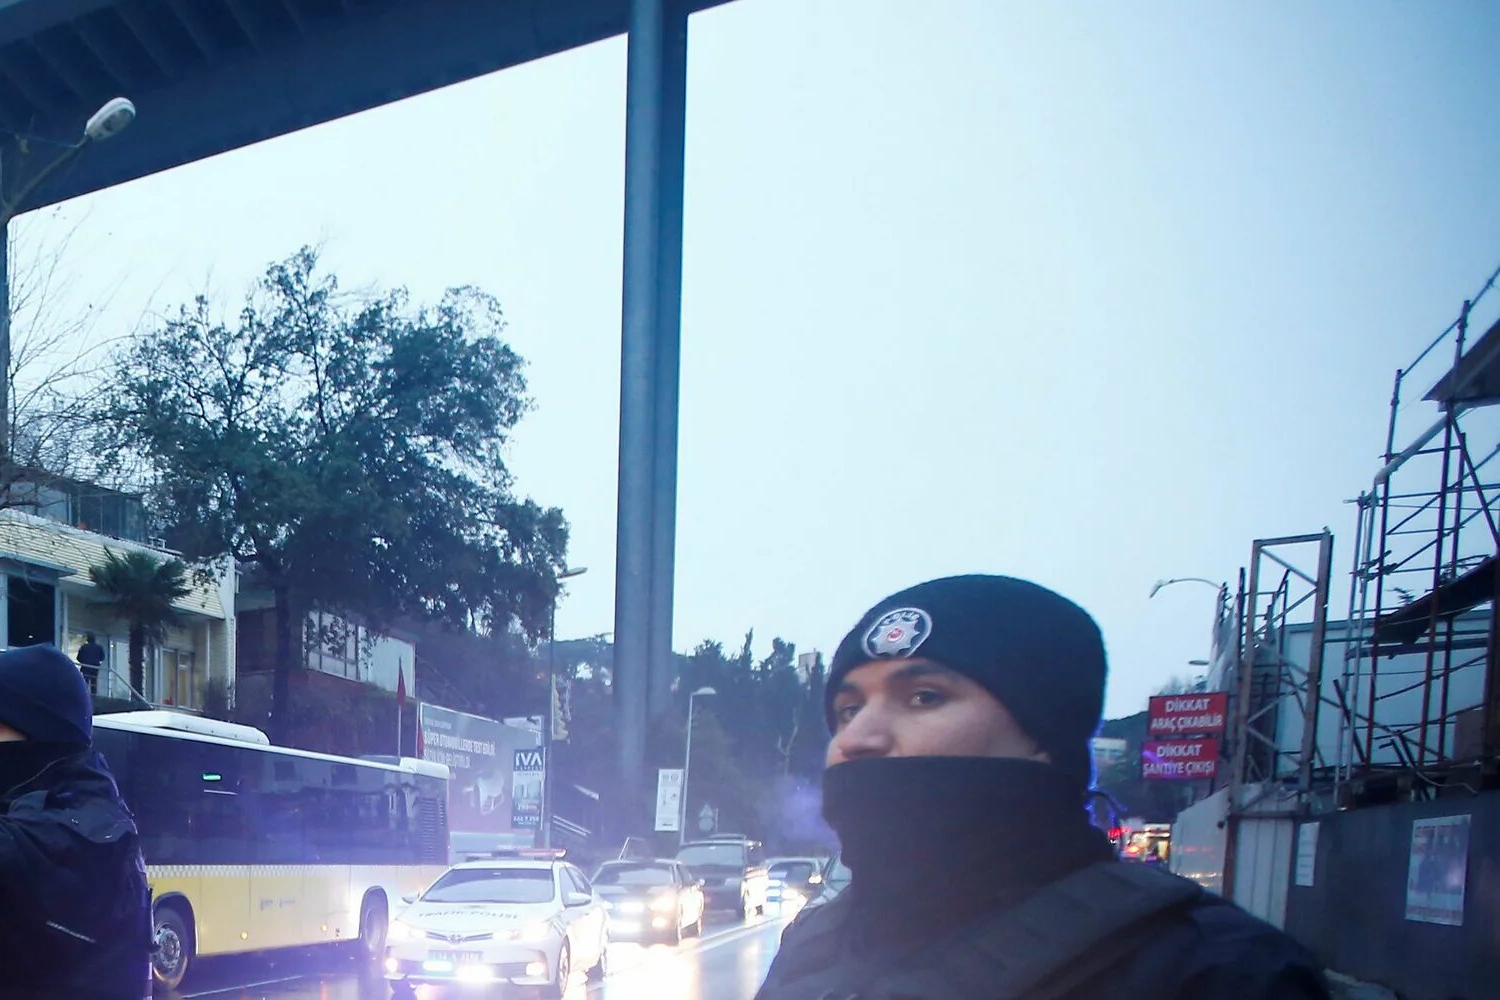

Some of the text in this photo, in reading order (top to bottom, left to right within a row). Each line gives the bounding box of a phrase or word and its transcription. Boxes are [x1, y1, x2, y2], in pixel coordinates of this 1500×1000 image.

[1165, 697, 1211, 712] DİKKAT
[1150, 717, 1176, 732] ARAÇ
[1156, 744, 1203, 758] DİKKAT
[1142, 761, 1184, 778] ŞANTİYE
